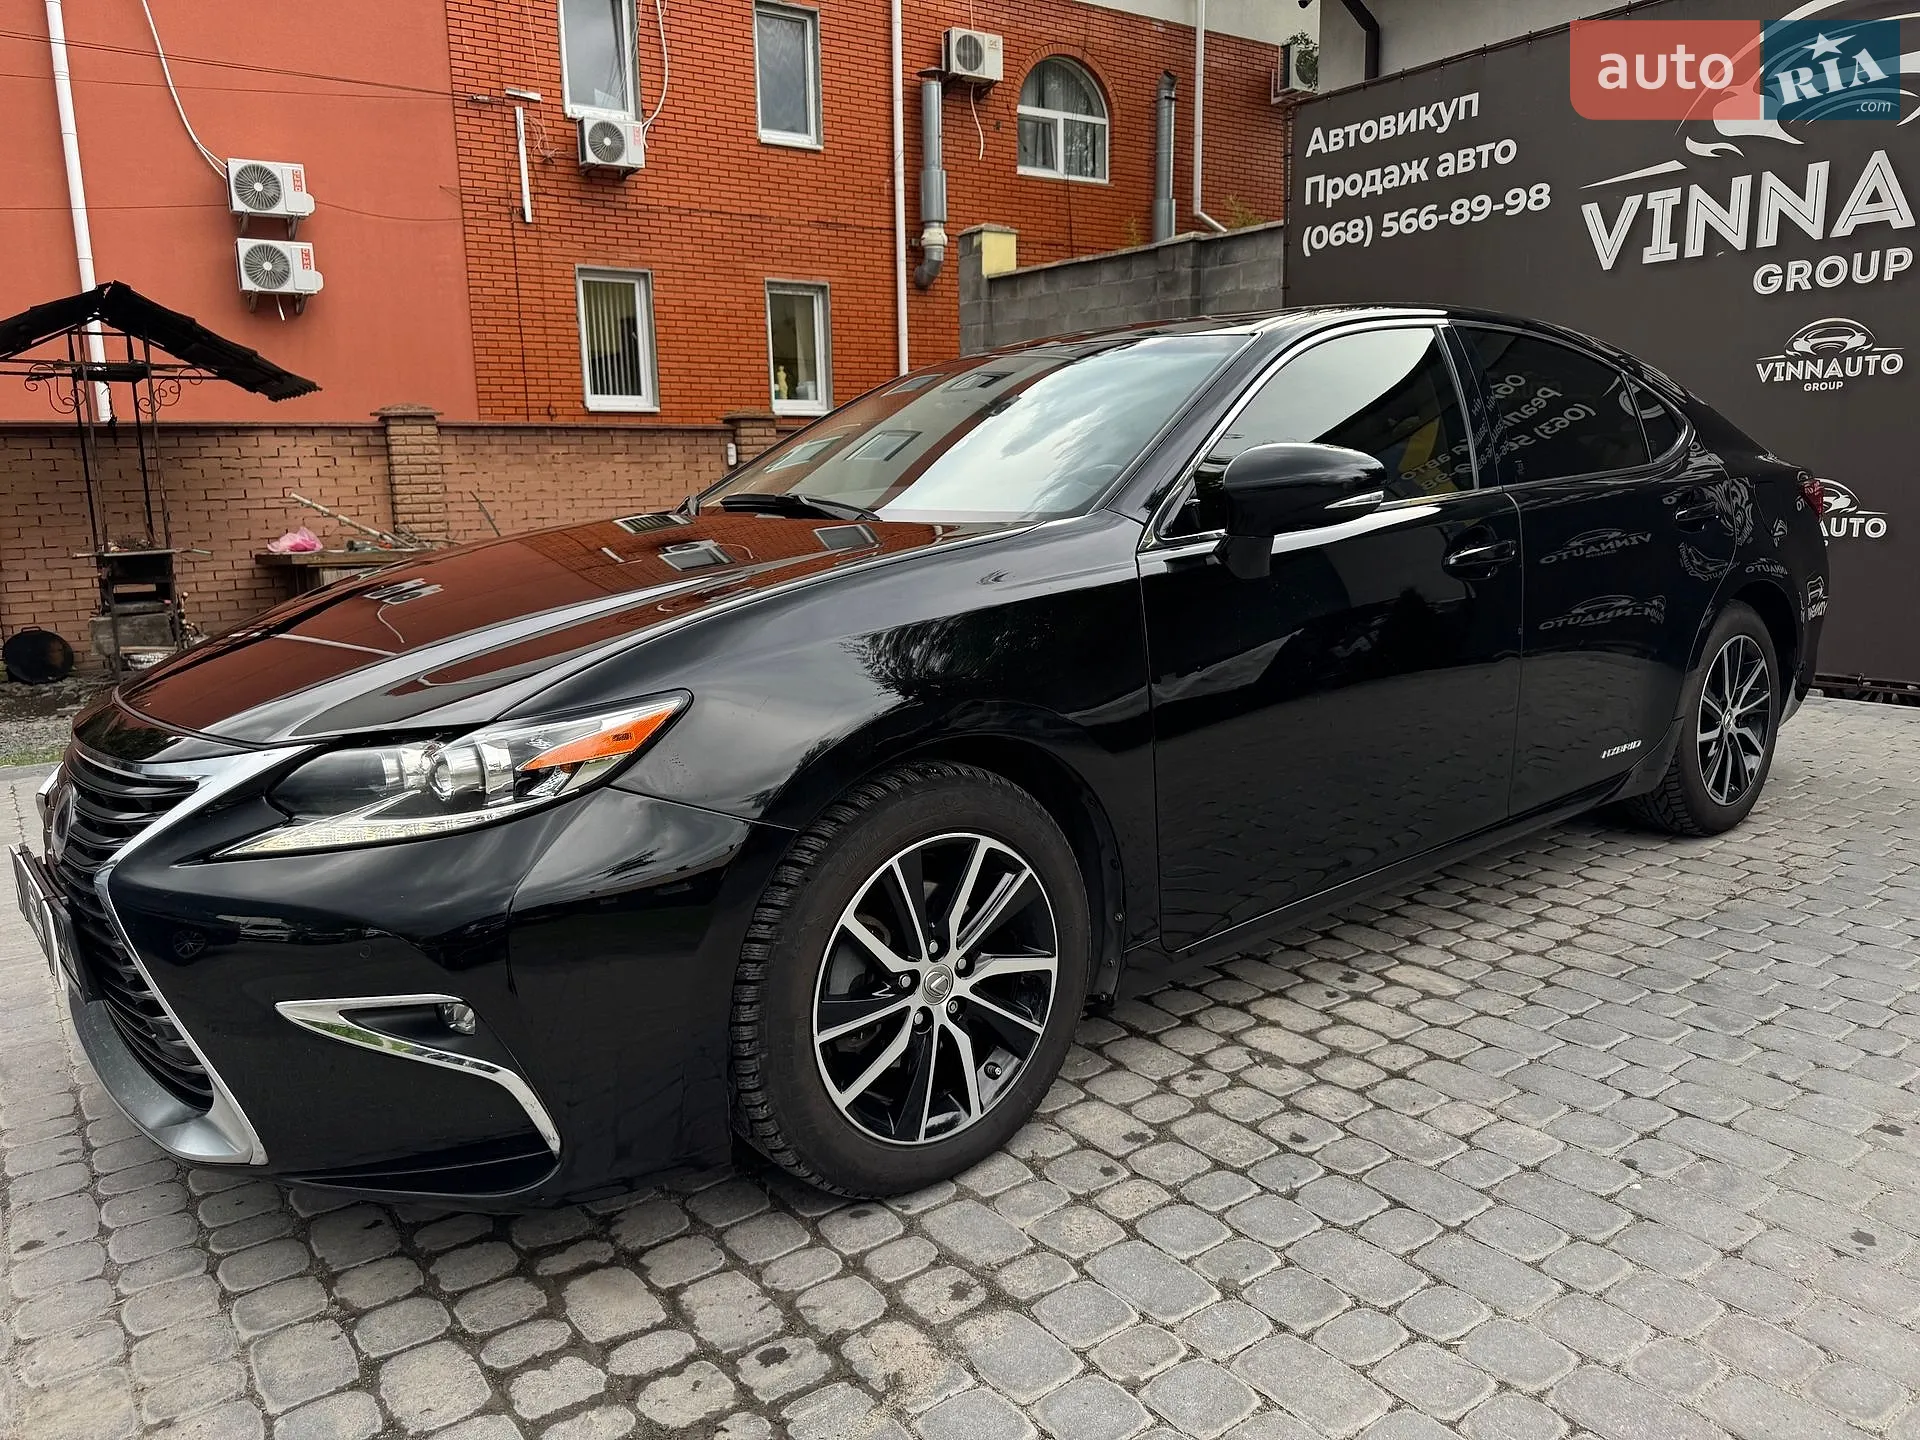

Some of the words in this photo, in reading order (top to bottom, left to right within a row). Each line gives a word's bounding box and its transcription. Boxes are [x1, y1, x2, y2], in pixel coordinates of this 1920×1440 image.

[1305, 91, 1480, 158] Автовикуп
[1304, 154, 1428, 206] Продаж
[1436, 137, 1518, 178] авто
[1301, 215, 1374, 258] (068)
[1380, 182, 1552, 240] 566-89-98
[1580, 148, 1916, 271] VINNA
[1752, 246, 1913, 296] GROUP
[1755, 353, 1904, 383] VINNAUTO
[1803, 381, 1844, 392] GROUP
